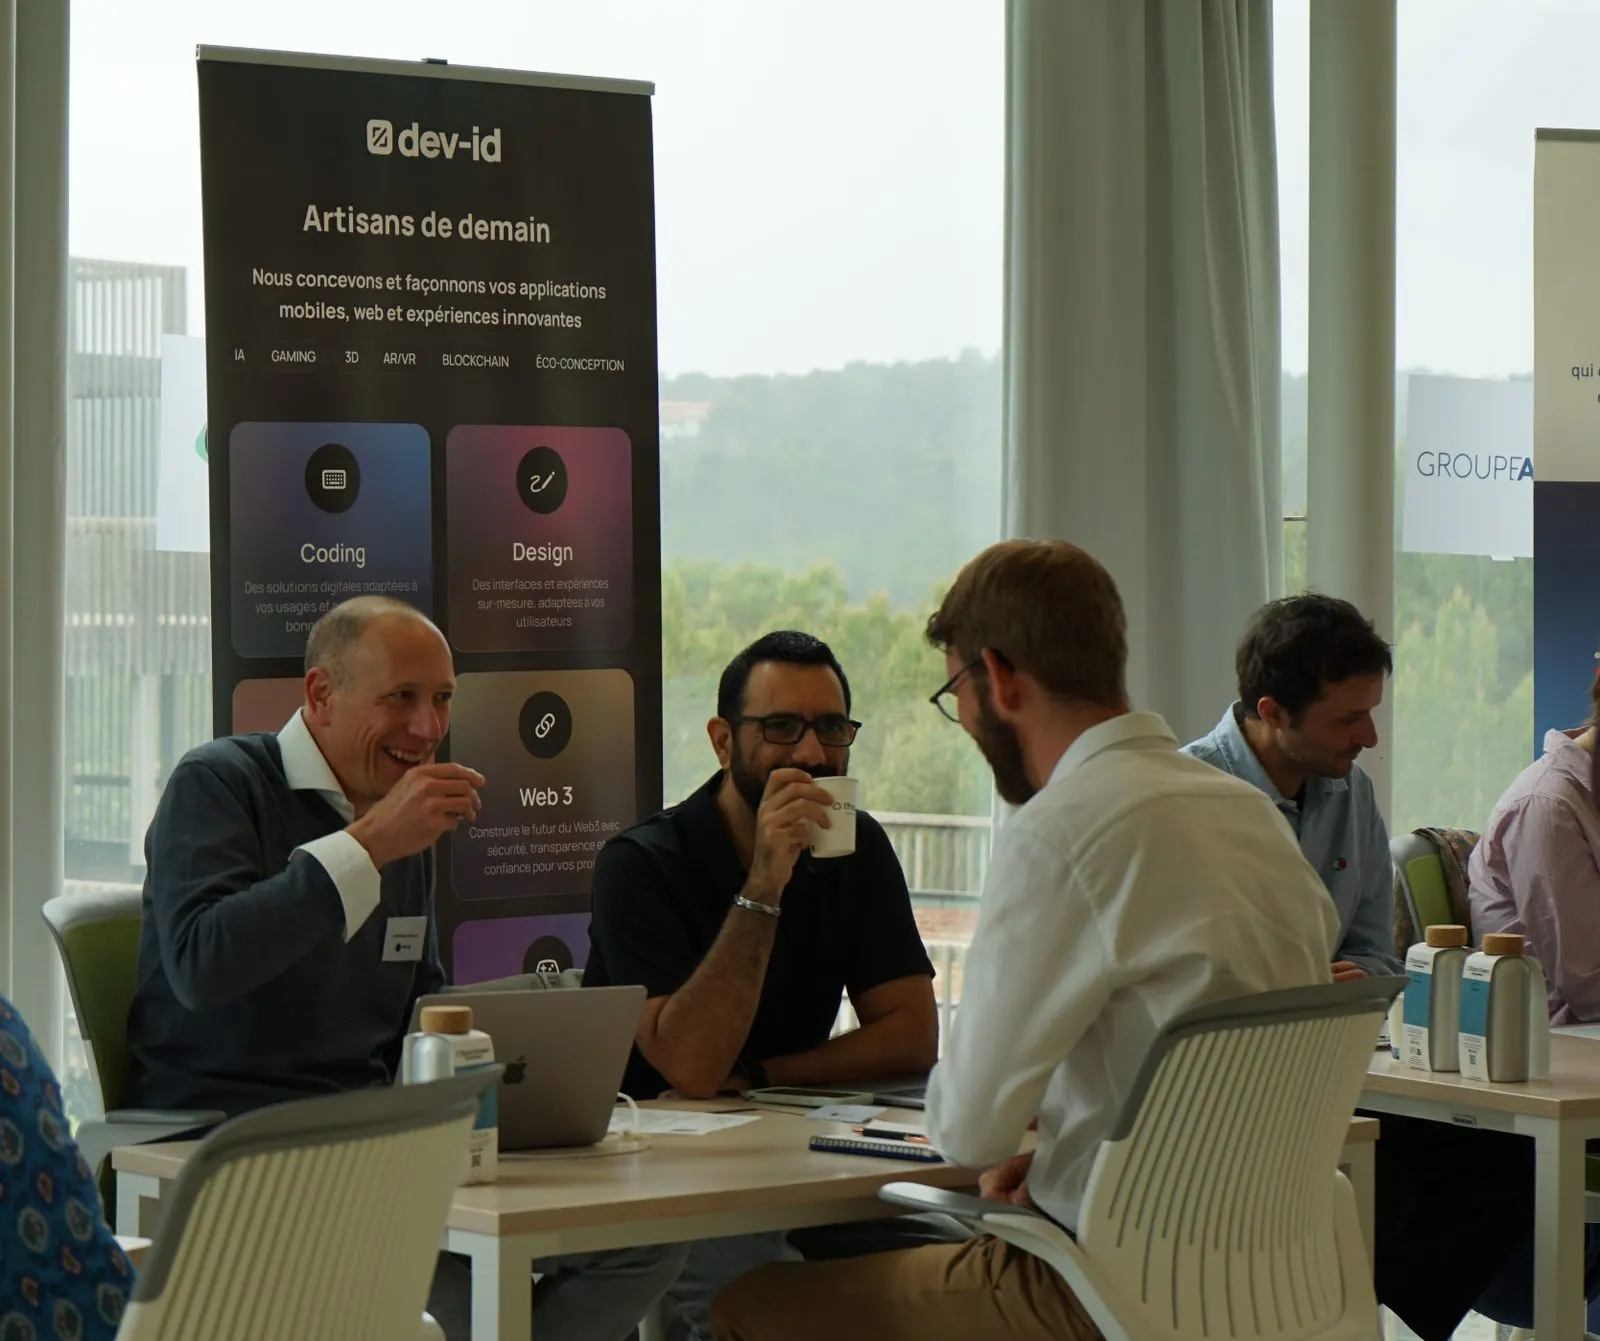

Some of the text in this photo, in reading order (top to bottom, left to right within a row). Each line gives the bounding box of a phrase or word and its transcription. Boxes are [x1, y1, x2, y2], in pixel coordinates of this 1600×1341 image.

[398, 123, 502, 163] dev-id
[303, 204, 551, 244] Artisans de demain
[252, 268, 606, 301] Nous concevons et façonnons vos applications
[279, 303, 582, 329] mobiles, web et expériences innovantes
[234, 349, 624, 371] IA GAMING 3D AR/VR BLOCKCHAIN ÉCO-CONCEPTION
[1571, 363, 1593, 381] qui
[300, 543, 366, 568] Coding
[512, 542, 573, 566] Design
[244, 581, 265, 593] Des
[266, 581, 318, 593] solutions
[320, 580, 362, 595] digitales
[362, 579, 410, 595] adaptées
[472, 578, 609, 592] Des interfaces et expériences
[256, 603, 273, 613] vos
[276, 602, 317, 616] usages
[319, 601, 329, 612] et
[478, 599, 536, 609] sur-mesure,
[538, 598, 582, 611] adaptées
[591, 598, 605, 608] vos
[286, 620, 316, 632] bonn
[516, 616, 572, 627] utilisateurs
[519, 786, 573, 807] Web 3
[469, 821, 620, 839] Construire le futur du Web3 avec
[530, 840, 595, 855] transparence
[484, 862, 531, 876] confiance
[532, 863, 556, 875] pour
[557, 861, 575, 871] vos
